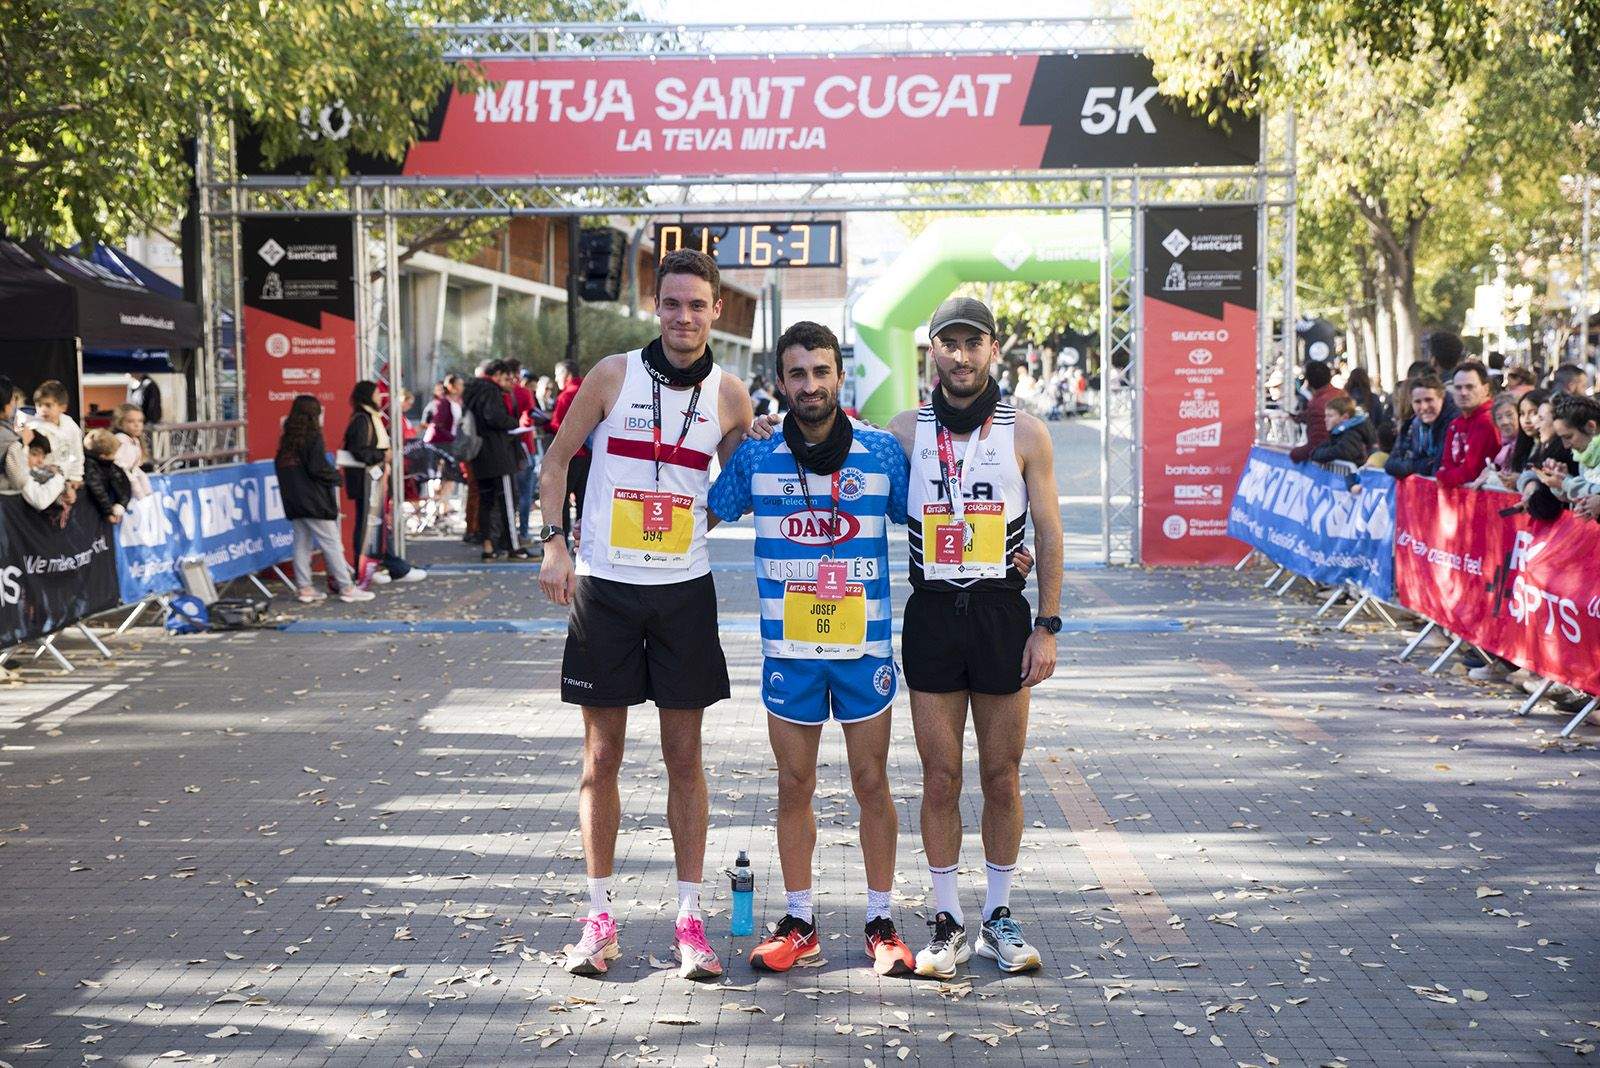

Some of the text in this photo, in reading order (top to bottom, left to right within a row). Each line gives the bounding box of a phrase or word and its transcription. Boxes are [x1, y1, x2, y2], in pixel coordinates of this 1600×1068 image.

[474, 73, 1011, 123] MITJA SANT CUGAT
[1079, 86, 1158, 135] 5K
[616, 127, 826, 151] LA TEVA MITJA
[1191, 241, 1243, 252] SantCugat
[1171, 331, 1216, 341] SILENCE
[617, 491, 638, 499] MITJA
[652, 502, 663, 516] 3
[787, 518, 842, 537] DANI
[944, 535, 955, 549] 2
[827, 571, 837, 585] 1
[810, 604, 837, 616] JOSEP
[816, 618, 831, 634] 66
[563, 677, 594, 690] TRIMTEX
